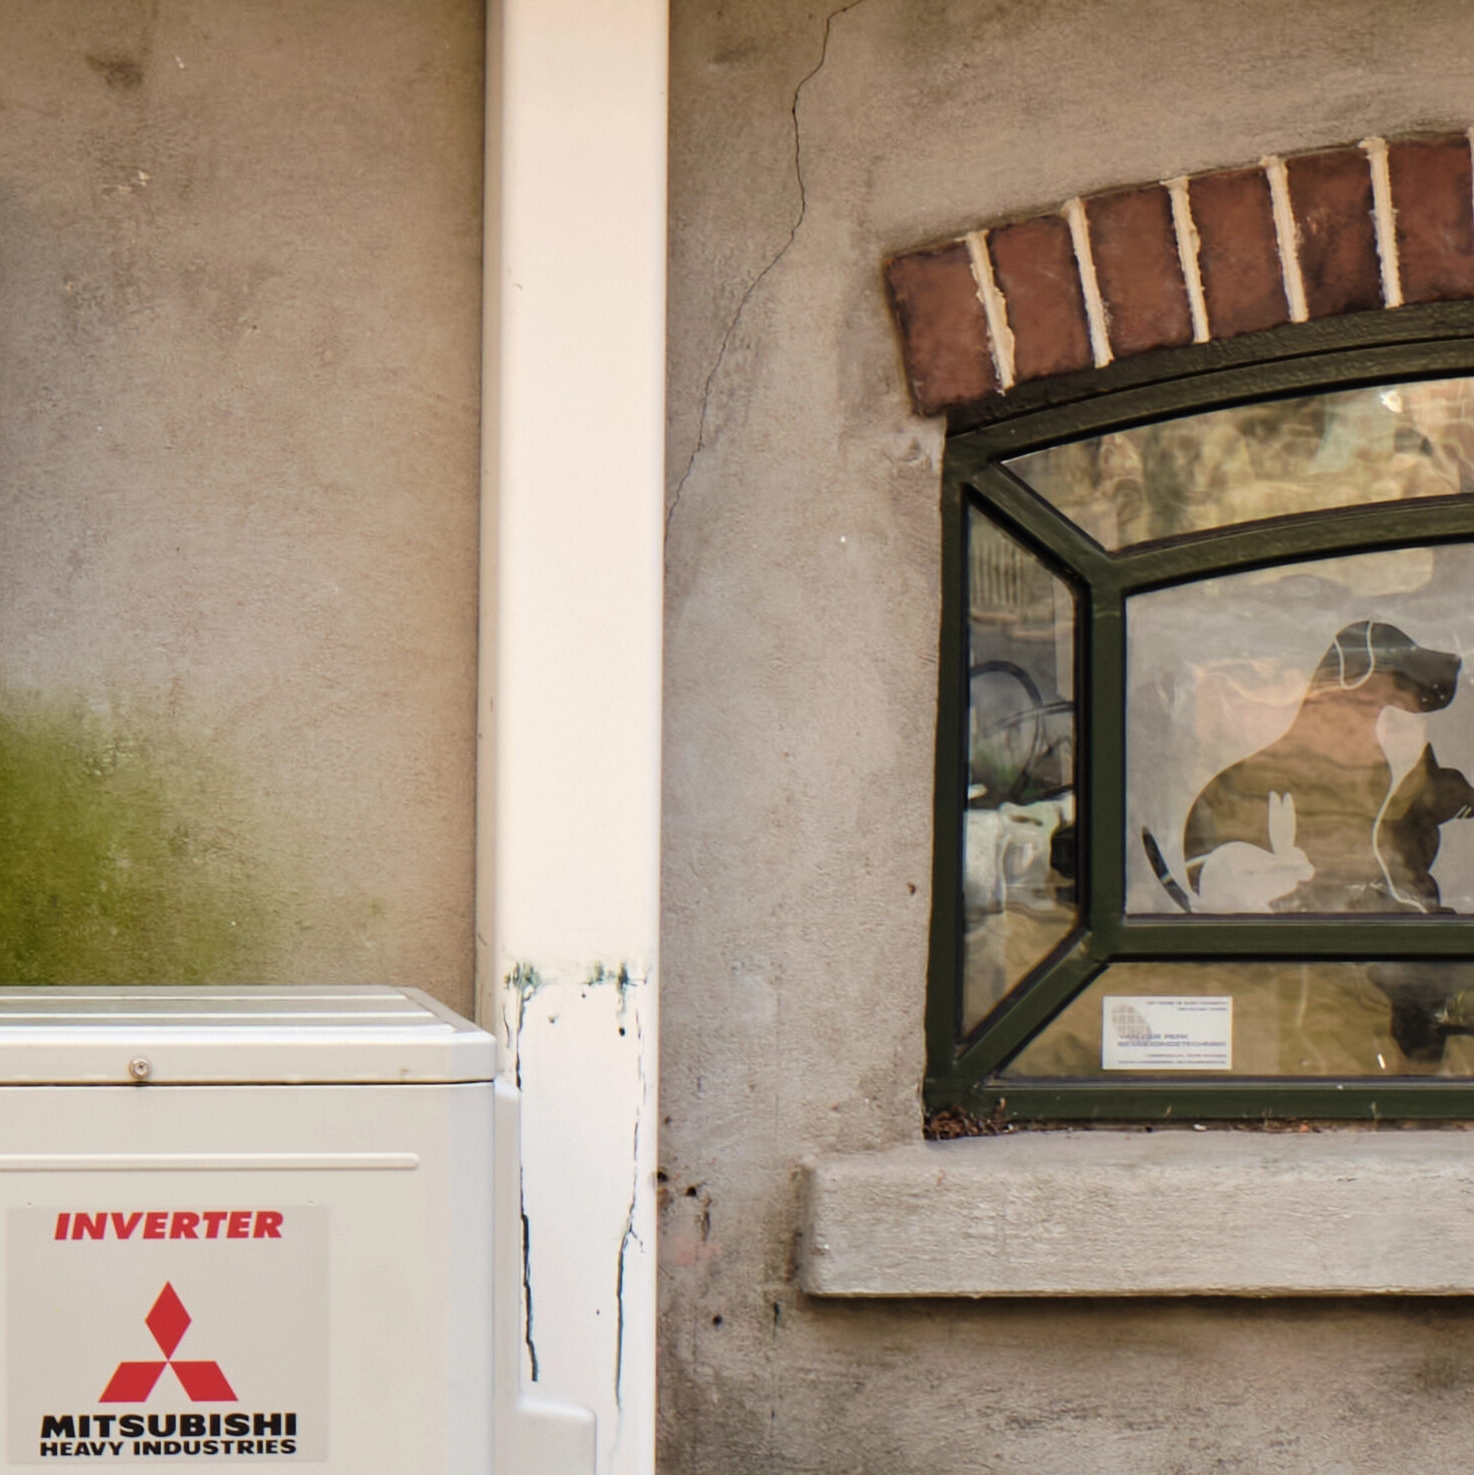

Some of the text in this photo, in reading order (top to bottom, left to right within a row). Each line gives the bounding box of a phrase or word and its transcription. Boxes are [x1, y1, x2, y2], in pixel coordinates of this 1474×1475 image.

[53, 1210, 284, 1241] INVERTER
[40, 1412, 297, 1438] MITSUBISHI
[40, 1438, 297, 1457] HEAVY INDUSTRIES
